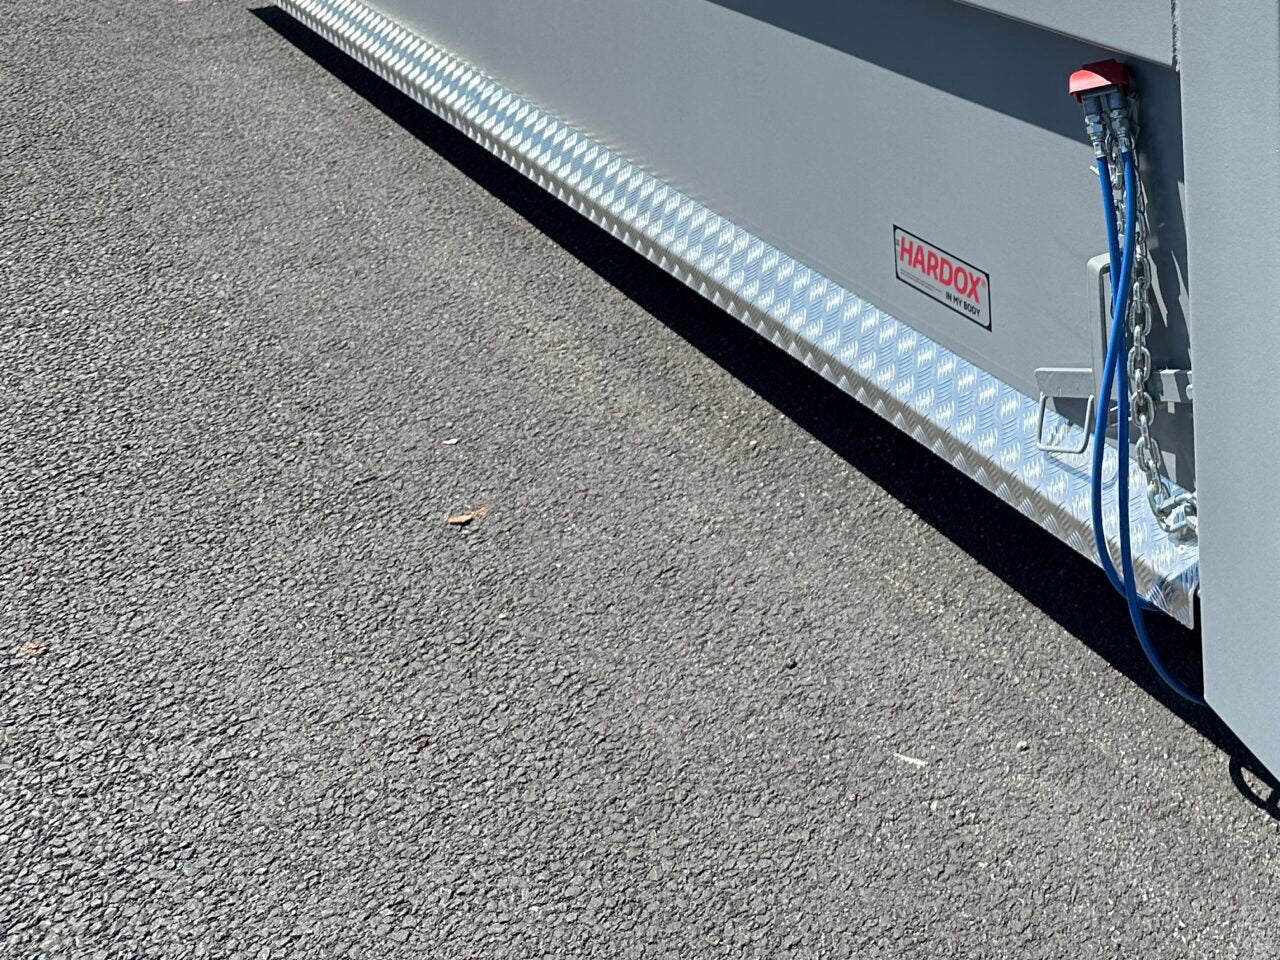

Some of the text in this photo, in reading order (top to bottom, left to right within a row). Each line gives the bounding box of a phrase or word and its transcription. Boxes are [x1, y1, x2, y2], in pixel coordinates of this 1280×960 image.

[899, 236, 981, 304] HARDOX
[945, 291, 981, 317] IN MY BODY
